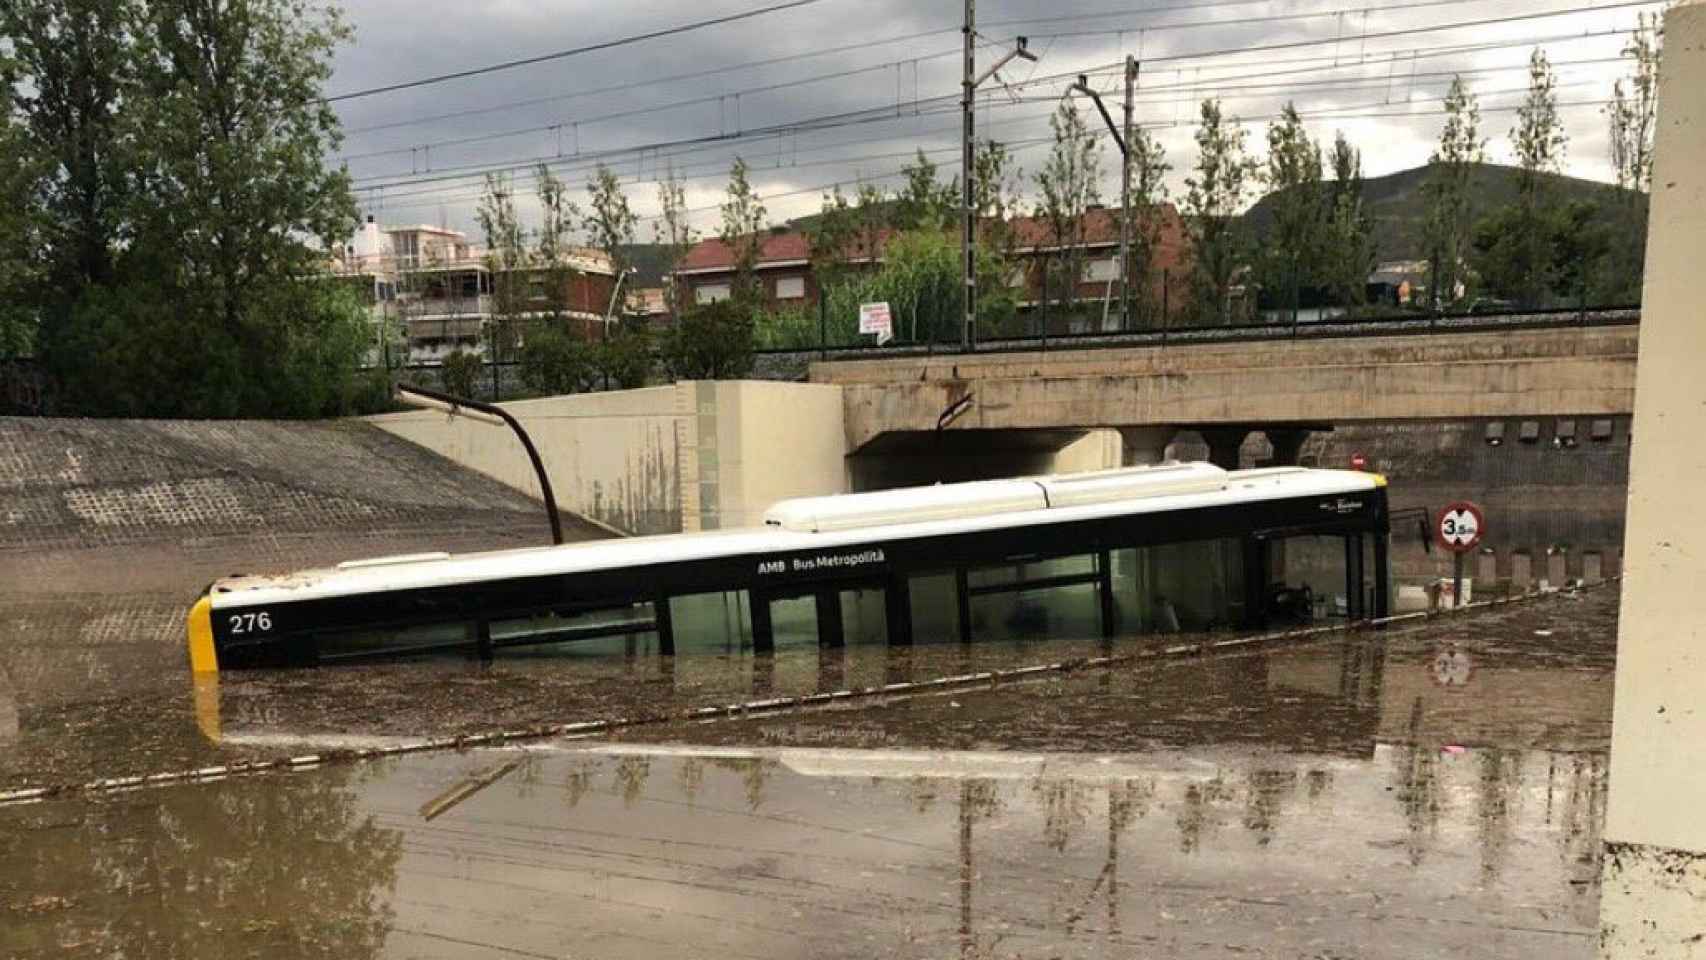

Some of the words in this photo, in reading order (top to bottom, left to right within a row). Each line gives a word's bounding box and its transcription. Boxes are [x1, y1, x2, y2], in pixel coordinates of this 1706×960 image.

[758, 560, 785, 574] AMB
[793, 558, 815, 571] Bus
[229, 612, 272, 633] 276
